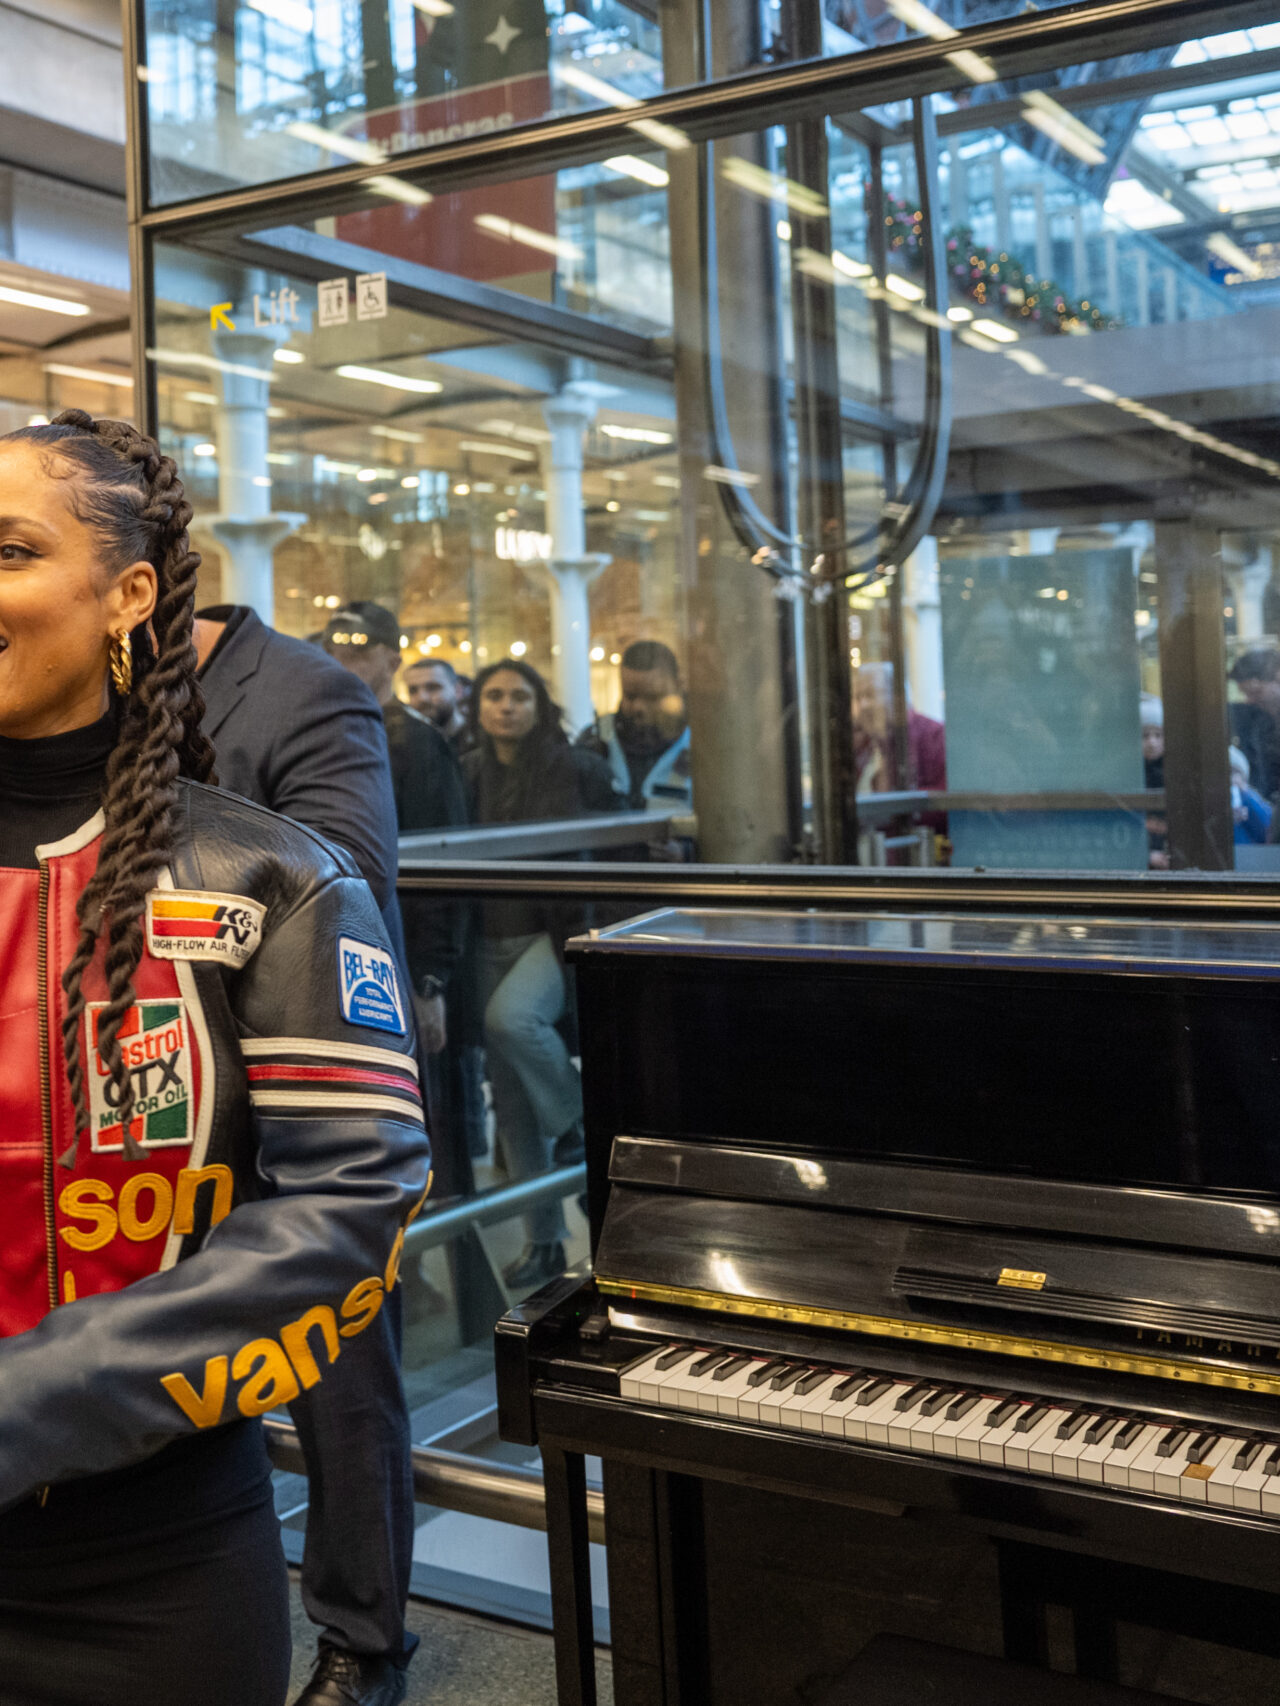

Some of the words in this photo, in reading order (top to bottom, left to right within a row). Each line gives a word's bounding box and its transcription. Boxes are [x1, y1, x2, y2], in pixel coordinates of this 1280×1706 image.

[253, 287, 300, 328] Lift
[152, 938, 206, 951] HIGH-FLOW
[210, 941, 228, 953] AIR
[213, 904, 258, 945] K&N
[343, 949, 398, 1007] BEL-RAY
[99, 1095, 158, 1128] MOOR
[165, 1083, 188, 1104] OIL
[58, 1163, 234, 1252] son
[160, 1169, 434, 1429] vans
